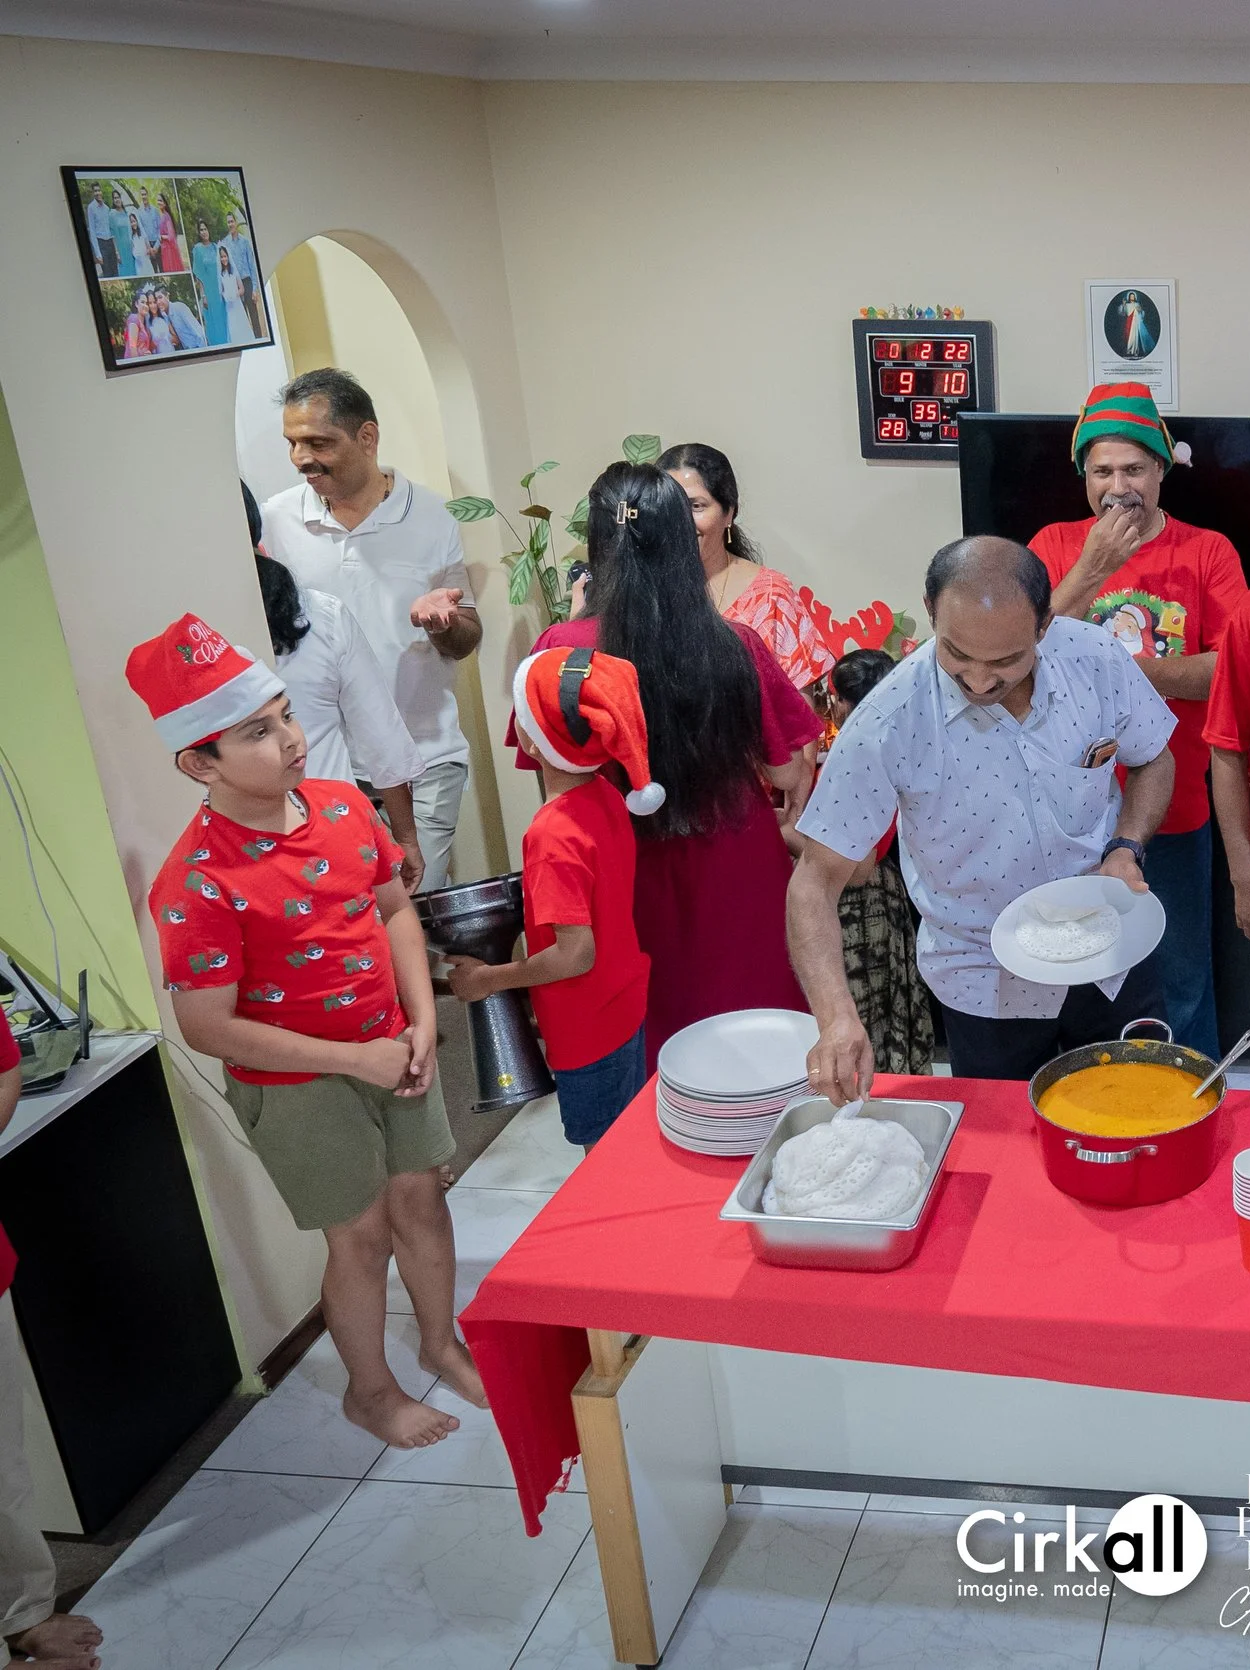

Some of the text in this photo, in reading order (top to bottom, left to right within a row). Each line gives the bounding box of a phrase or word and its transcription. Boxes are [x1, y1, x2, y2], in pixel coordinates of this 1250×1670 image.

[945, 343, 968, 359] 22
[944, 372, 965, 394] 10
[915, 404, 936, 420] 35
[881, 421, 903, 437] 28
